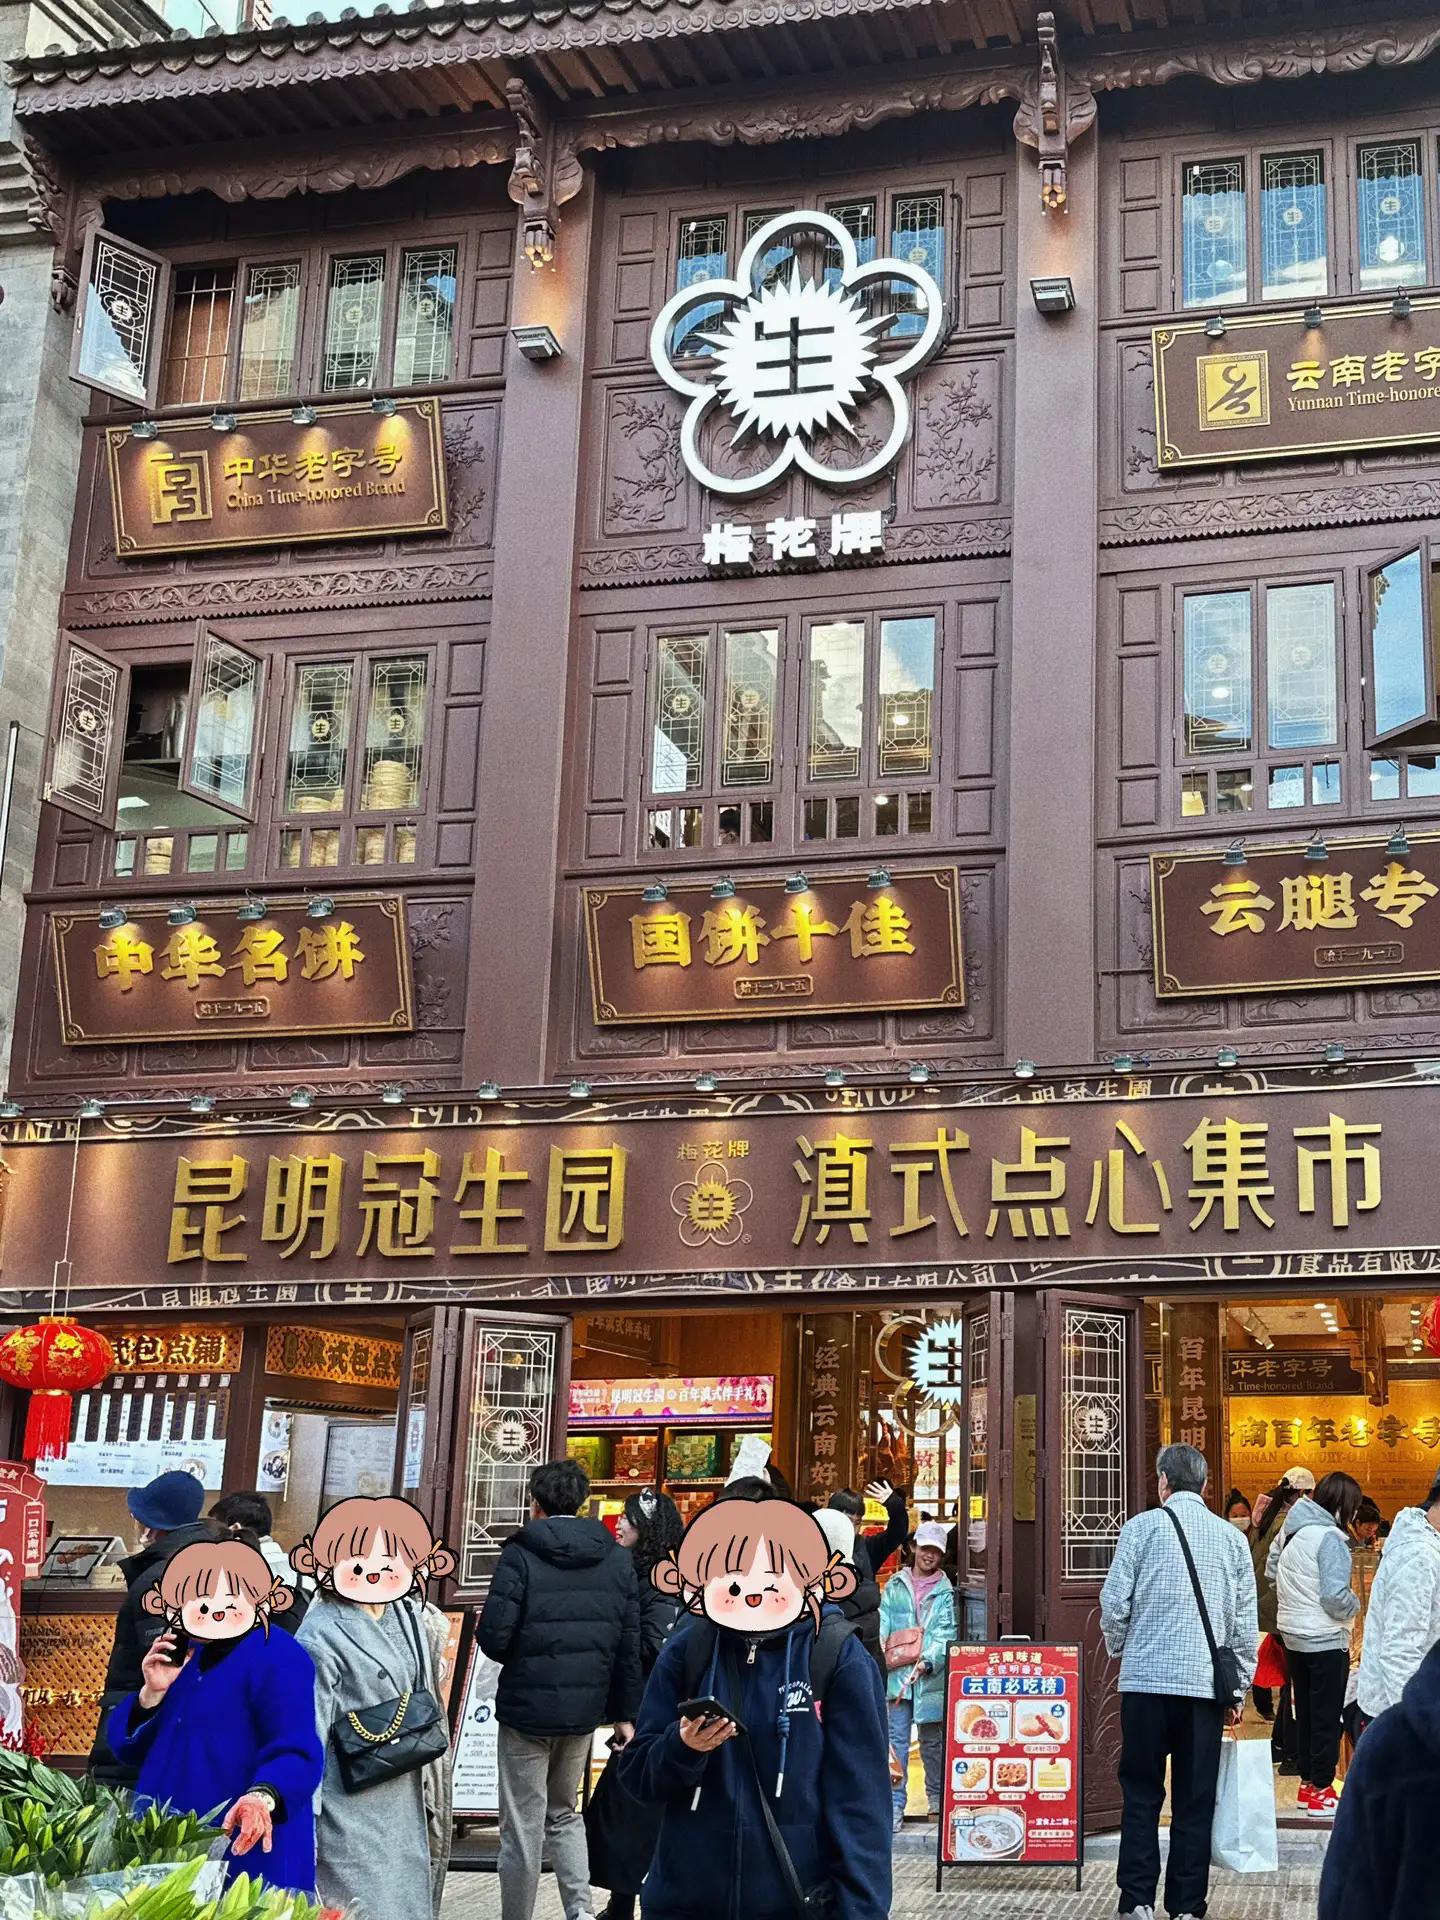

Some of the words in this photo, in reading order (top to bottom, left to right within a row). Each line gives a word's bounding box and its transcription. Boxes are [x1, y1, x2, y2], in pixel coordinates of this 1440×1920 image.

[1287, 346, 1440, 391] 云南老字
[1288, 395, 1343, 412] Yunnan
[223, 444, 402, 489] 中华老字号
[227, 491, 263, 509] China
[267, 480, 362, 504] Time-honored
[366, 478, 405, 496] Brand
[702, 510, 884, 566] 梅花牌
[1199, 862, 1439, 936] 云腿专
[627, 896, 916, 969] 国饼十佳
[1321, 946, 1398, 964] 始于一九一五
[92, 921, 366, 992] 中华名饼
[677, 1140, 749, 1161] 梅花牌
[792, 1111, 1383, 1245] 滇式点心集市
[167, 1142, 628, 1264] 昆明冠生园
[303, 1338, 402, 1382] 滇式包点
[1178, 1336, 1208, 1452] 百年昆明
[1231, 1452, 1277, 1464] UNNAN
[988, 1651, 1042, 1664] 云南味道
[968, 1678, 1057, 1694] 云南必吃榜
